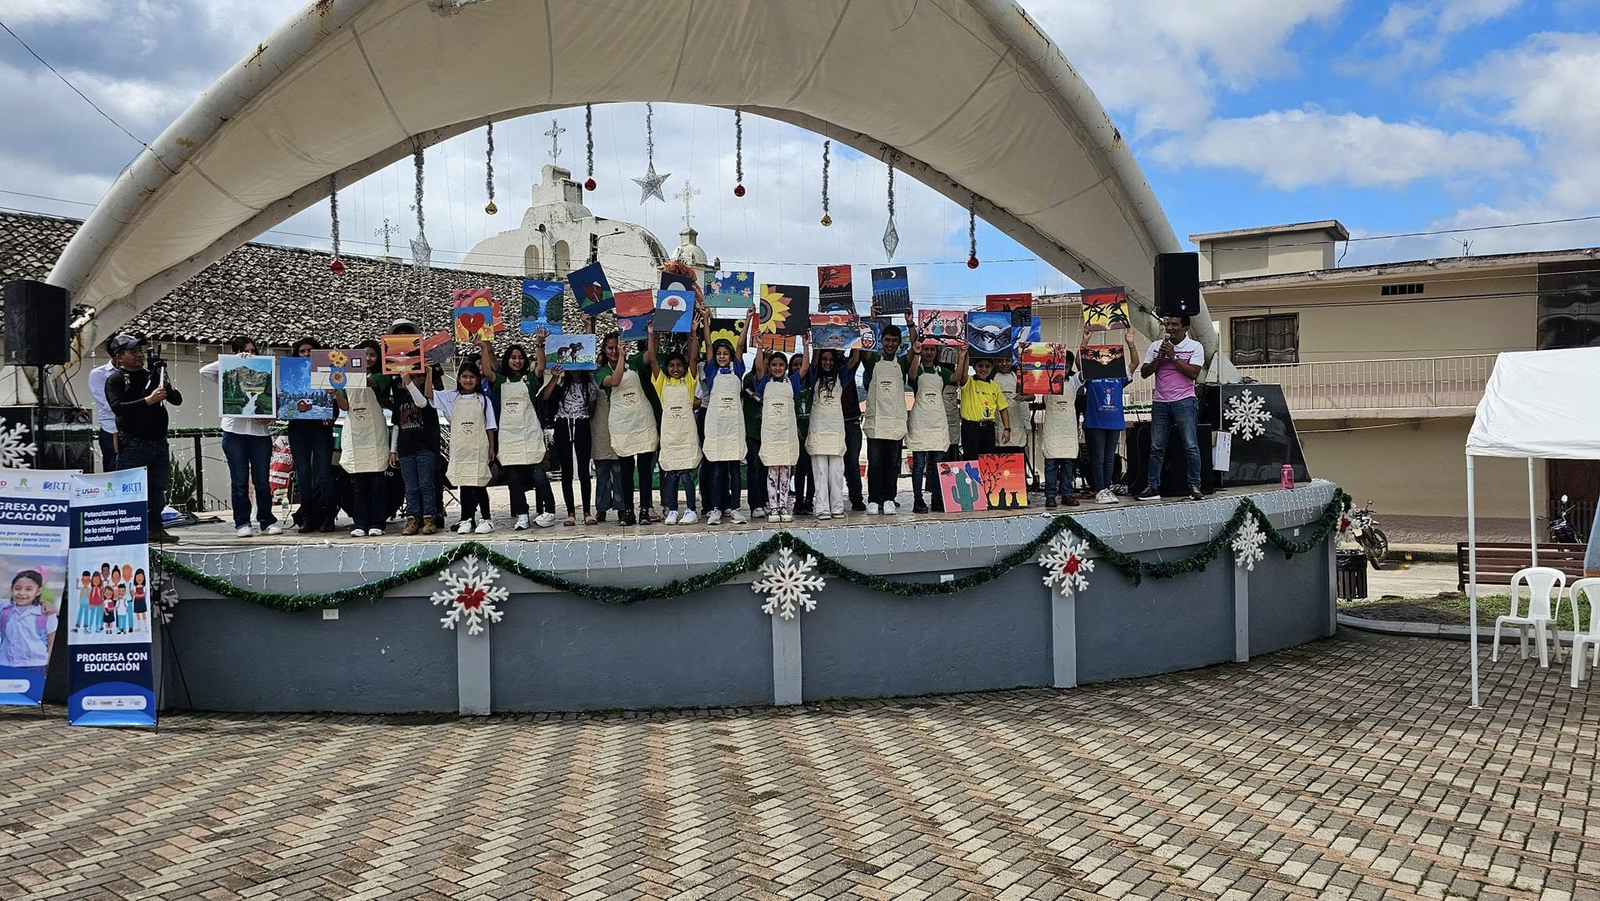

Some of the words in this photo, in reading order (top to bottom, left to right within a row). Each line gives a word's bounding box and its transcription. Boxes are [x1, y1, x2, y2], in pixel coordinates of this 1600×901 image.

[128, 482, 142, 492] RTI
[40, 504, 68, 512] CON
[84, 510, 118, 518] Potenciamos
[84, 518, 115, 526] habilidades
[116, 524, 140, 534] juventud
[76, 652, 125, 662] PROGRESA
[126, 652, 148, 661] CON
[84, 660, 140, 672] EDUCACIÓN
